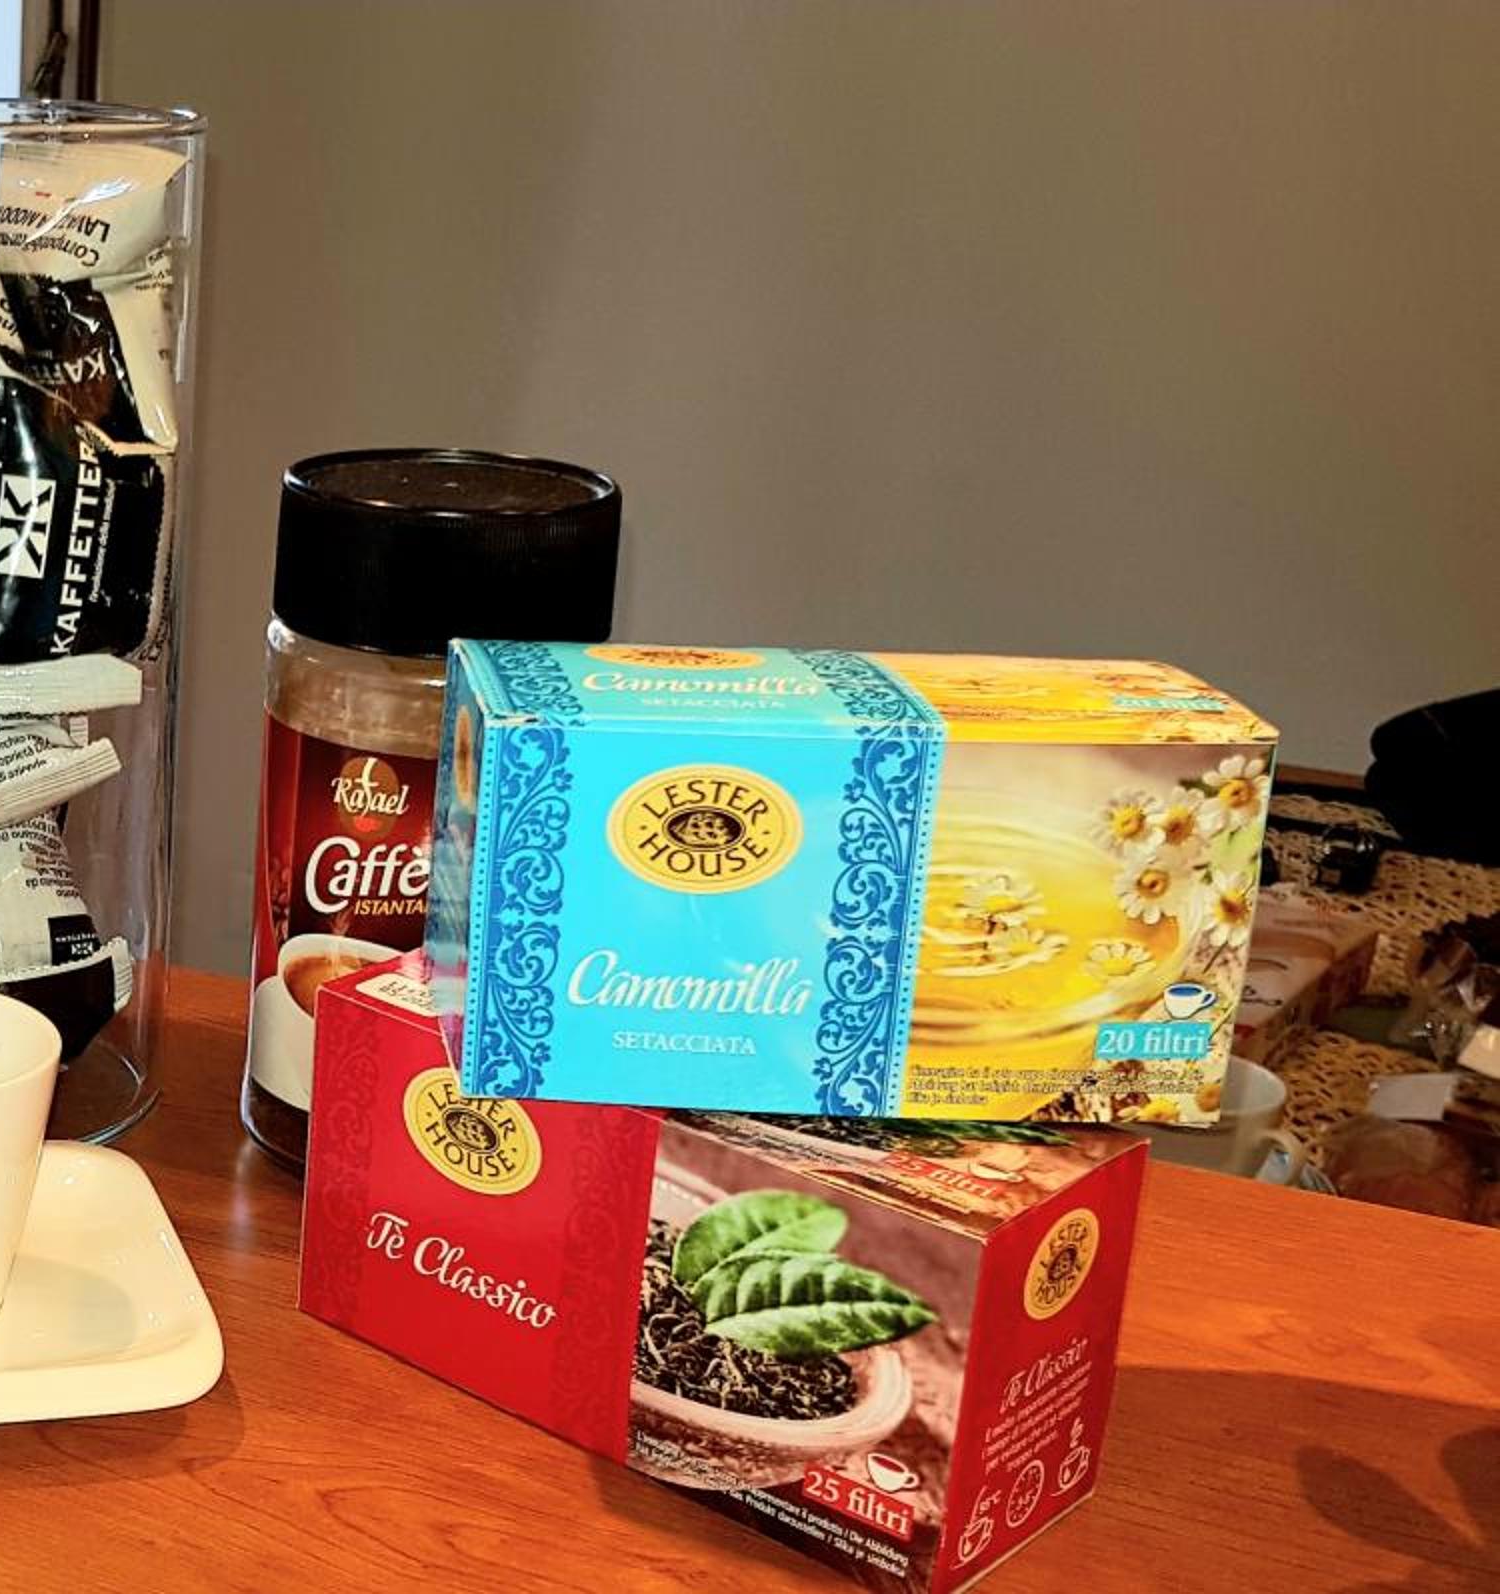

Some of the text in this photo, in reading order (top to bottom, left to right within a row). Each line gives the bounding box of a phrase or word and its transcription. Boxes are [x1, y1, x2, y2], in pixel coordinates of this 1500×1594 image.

[332, 757, 410, 817] Rafael
[641, 779, 769, 825] LESTER
[305, 836, 430, 914] Caffè
[638, 831, 769, 877] HOUSE
[567, 948, 814, 1017] Camomilla
[612, 1031, 757, 1056] SETACCIATA
[1101, 1026, 1206, 1055] 20 filtri
[425, 1121, 516, 1177] HOUSE
[366, 1211, 557, 1329] Tè Classico
[805, 1470, 910, 1536] 25 filtri
